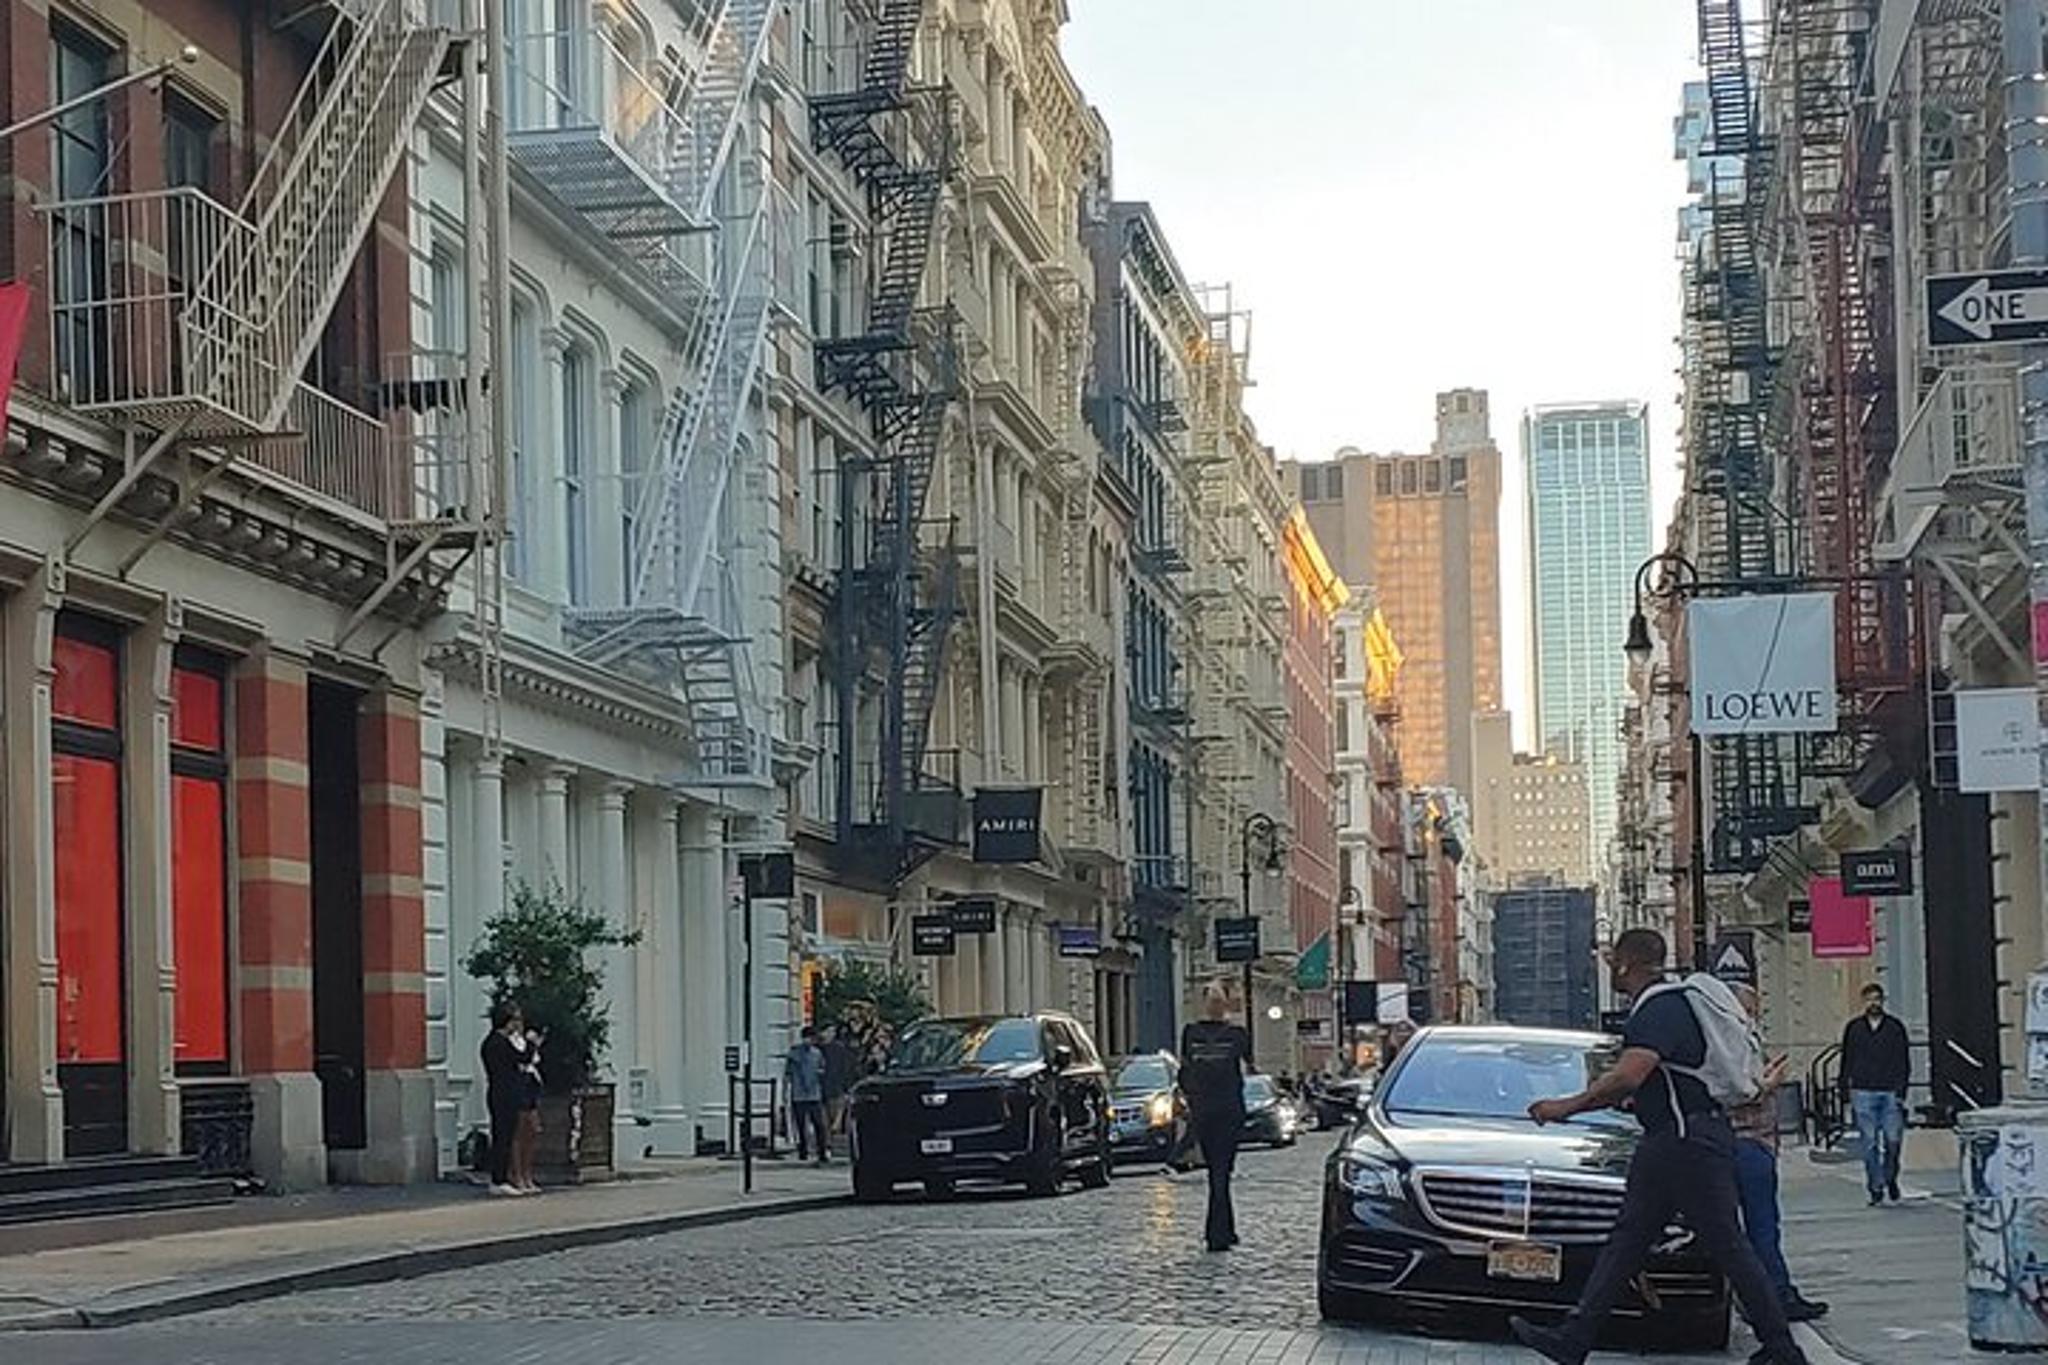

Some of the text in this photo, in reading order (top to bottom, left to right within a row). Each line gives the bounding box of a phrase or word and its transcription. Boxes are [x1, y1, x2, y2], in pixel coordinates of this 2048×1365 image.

[1962, 293, 2026, 322] ONE
[1705, 690, 1822, 720] LOEWE
[978, 818, 1035, 832] AMIRI
[1857, 858, 1896, 877] ami
